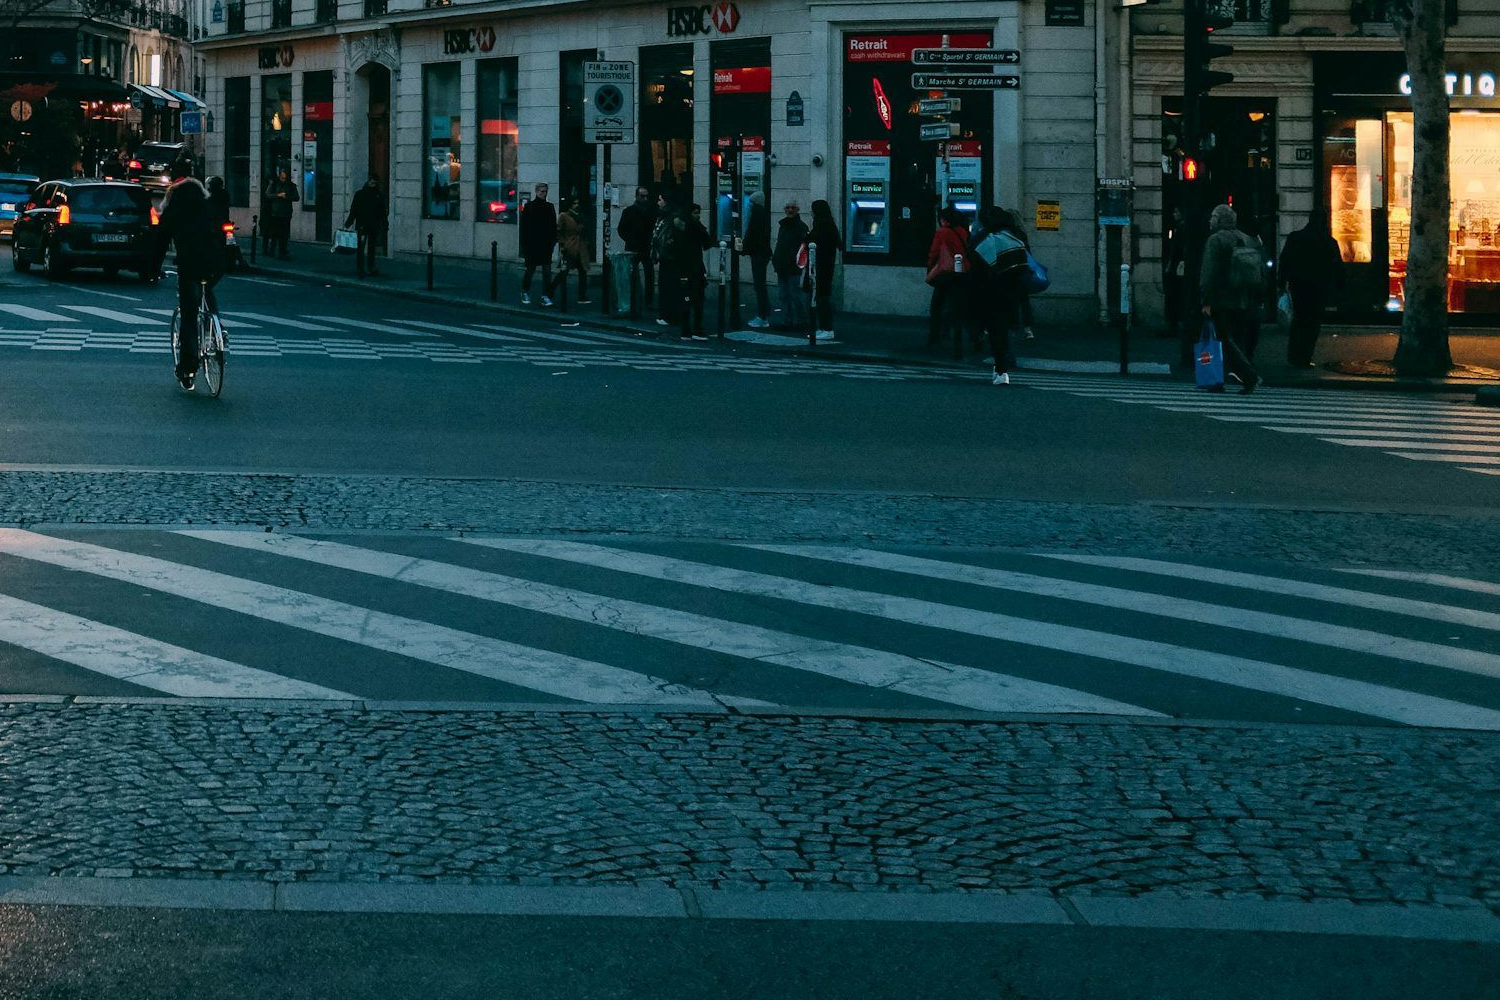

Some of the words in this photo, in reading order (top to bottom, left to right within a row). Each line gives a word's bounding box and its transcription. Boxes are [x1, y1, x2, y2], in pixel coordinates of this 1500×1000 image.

[667, 5, 712, 37] HSBC
[444, 28, 475, 55] HSBC
[850, 38, 888, 50] Retrait
[942, 53, 964, 62] Sportif
[974, 53, 1005, 61] GERMAIN
[588, 63, 601, 71] FIN
[609, 63, 629, 71] ZONE
[587, 72, 631, 80] TOURISTIQUE
[714, 72, 733, 83] Retrait
[928, 77, 956, 85] Marché
[967, 77, 1003, 85] GERMAIN
[848, 142, 872, 150] Retrait
[1099, 178, 1131, 186] GOSPEL
[853, 184, 861, 192] En
[862, 184, 882, 192] service
